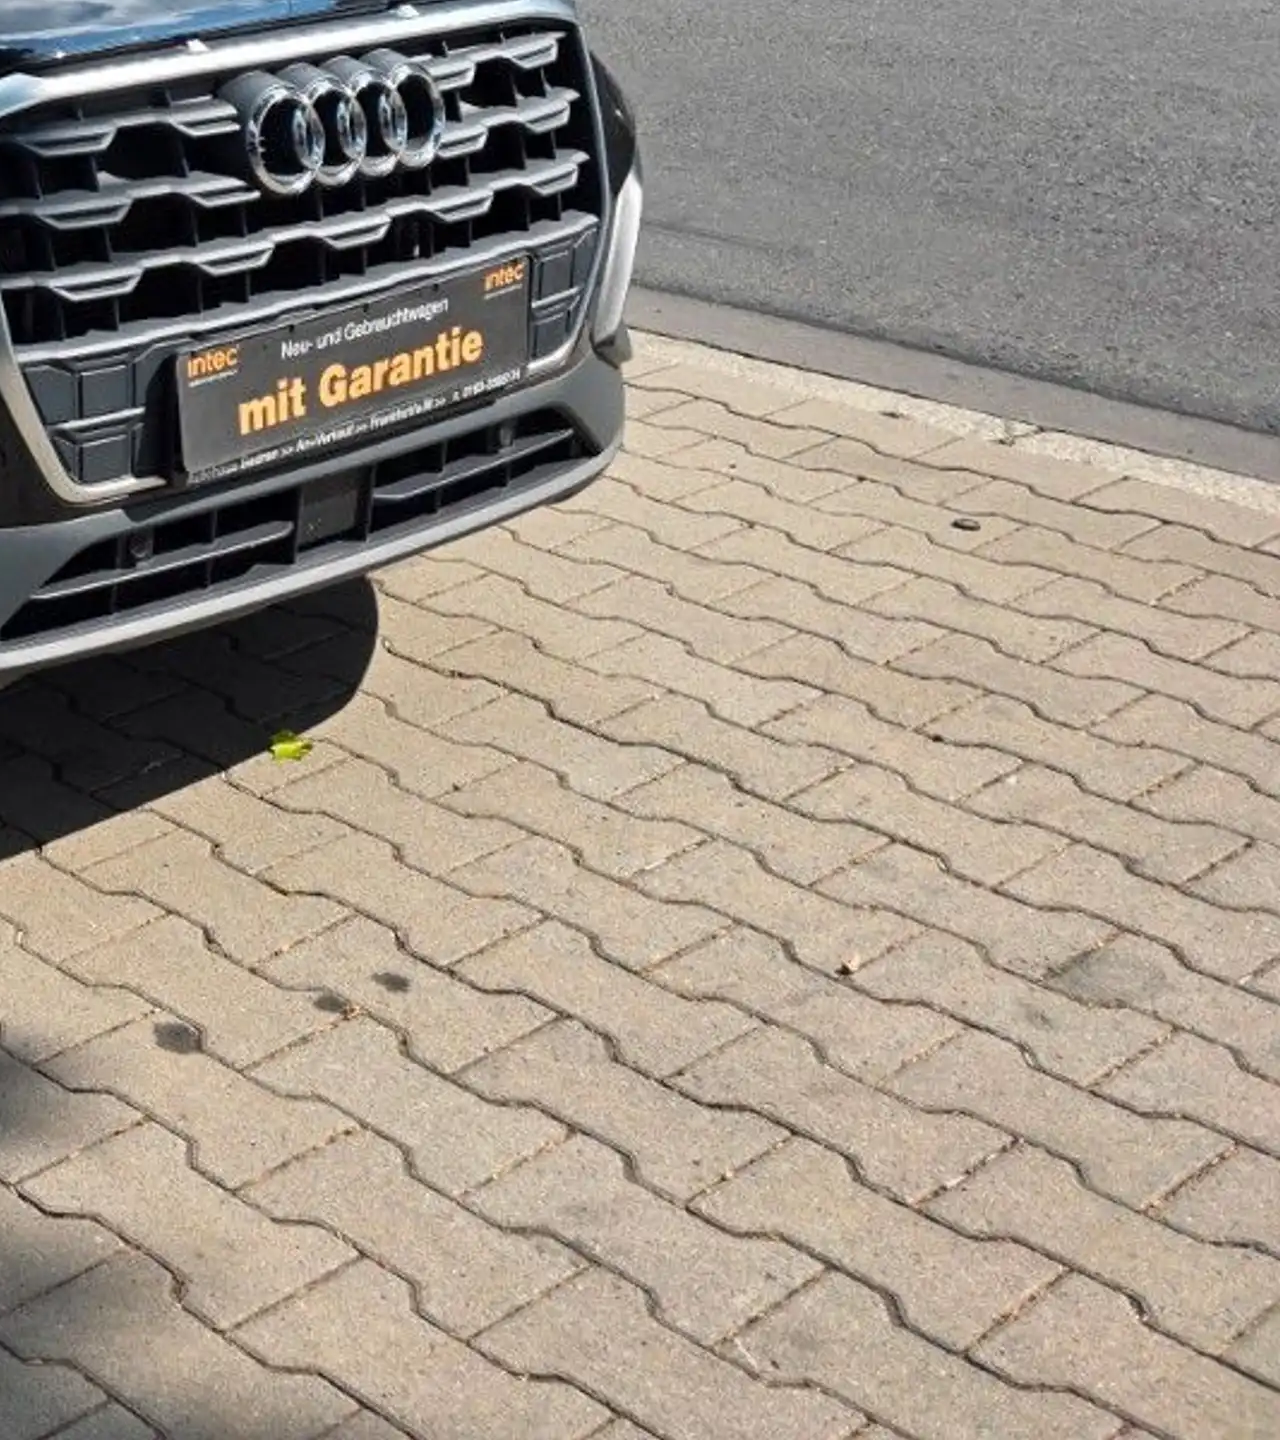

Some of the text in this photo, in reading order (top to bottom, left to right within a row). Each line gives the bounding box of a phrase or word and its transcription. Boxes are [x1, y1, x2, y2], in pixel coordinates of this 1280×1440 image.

[281, 298, 449, 359] Neu- und Gebrauchtwagen
[187, 347, 238, 378] intec
[238, 376, 307, 436] mit
[318, 324, 484, 408] Garantie
